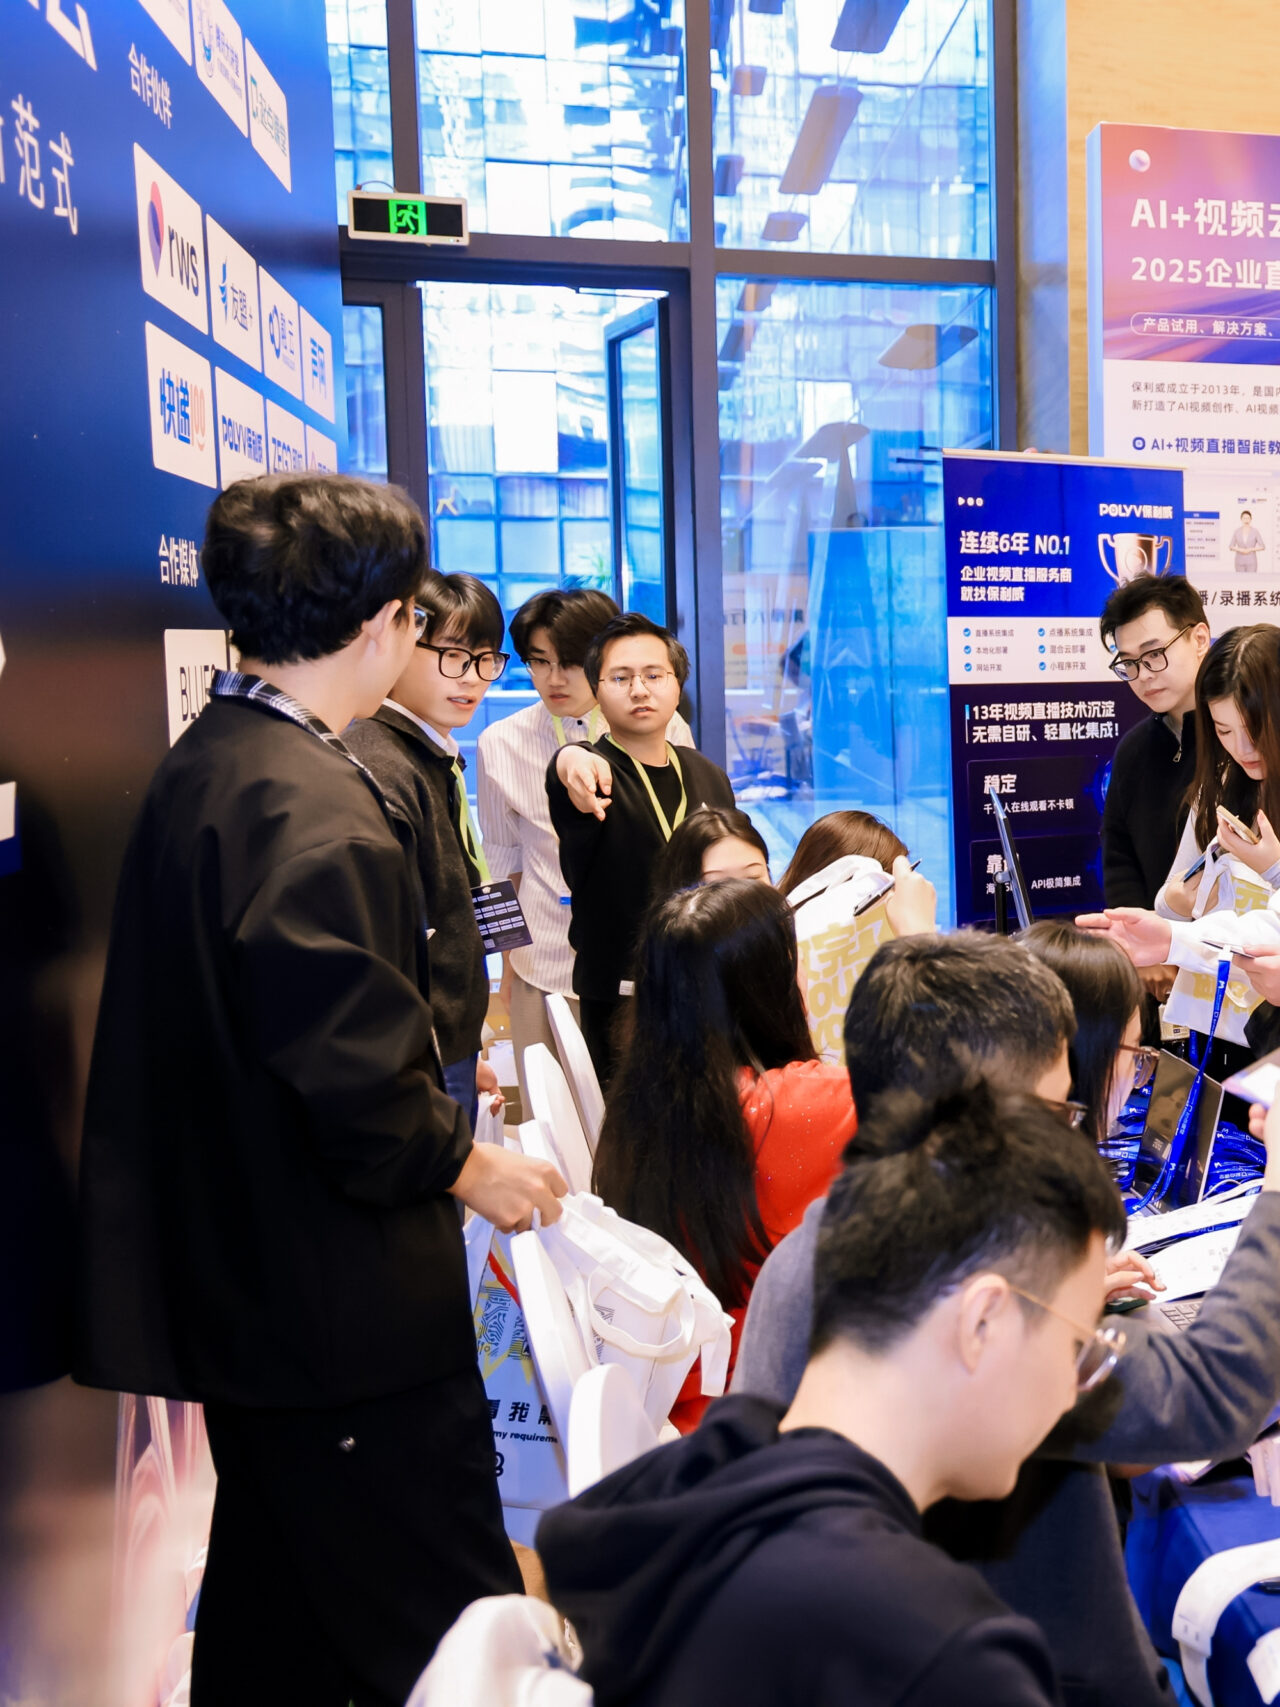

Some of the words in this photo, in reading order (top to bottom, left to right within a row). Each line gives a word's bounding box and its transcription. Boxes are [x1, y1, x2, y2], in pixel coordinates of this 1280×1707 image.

[128, 42, 173, 130] 合作伙伴
[0, 93, 78, 235] 范式
[167, 224, 199, 297] rws
[1099, 503, 1173, 519] POLYV保利威
[960, 531, 1029, 554] 连续6年
[1034, 535, 1070, 555] NO.1
[158, 534, 199, 587] 合作媒体
[960, 566, 1072, 583] 企业视频直播服务商
[961, 586, 1025, 602] 就找保利威
[972, 701, 1116, 720] 13年视频直播技术沉淀
[983, 798, 1075, 815] 千人在线观看不卡顿
